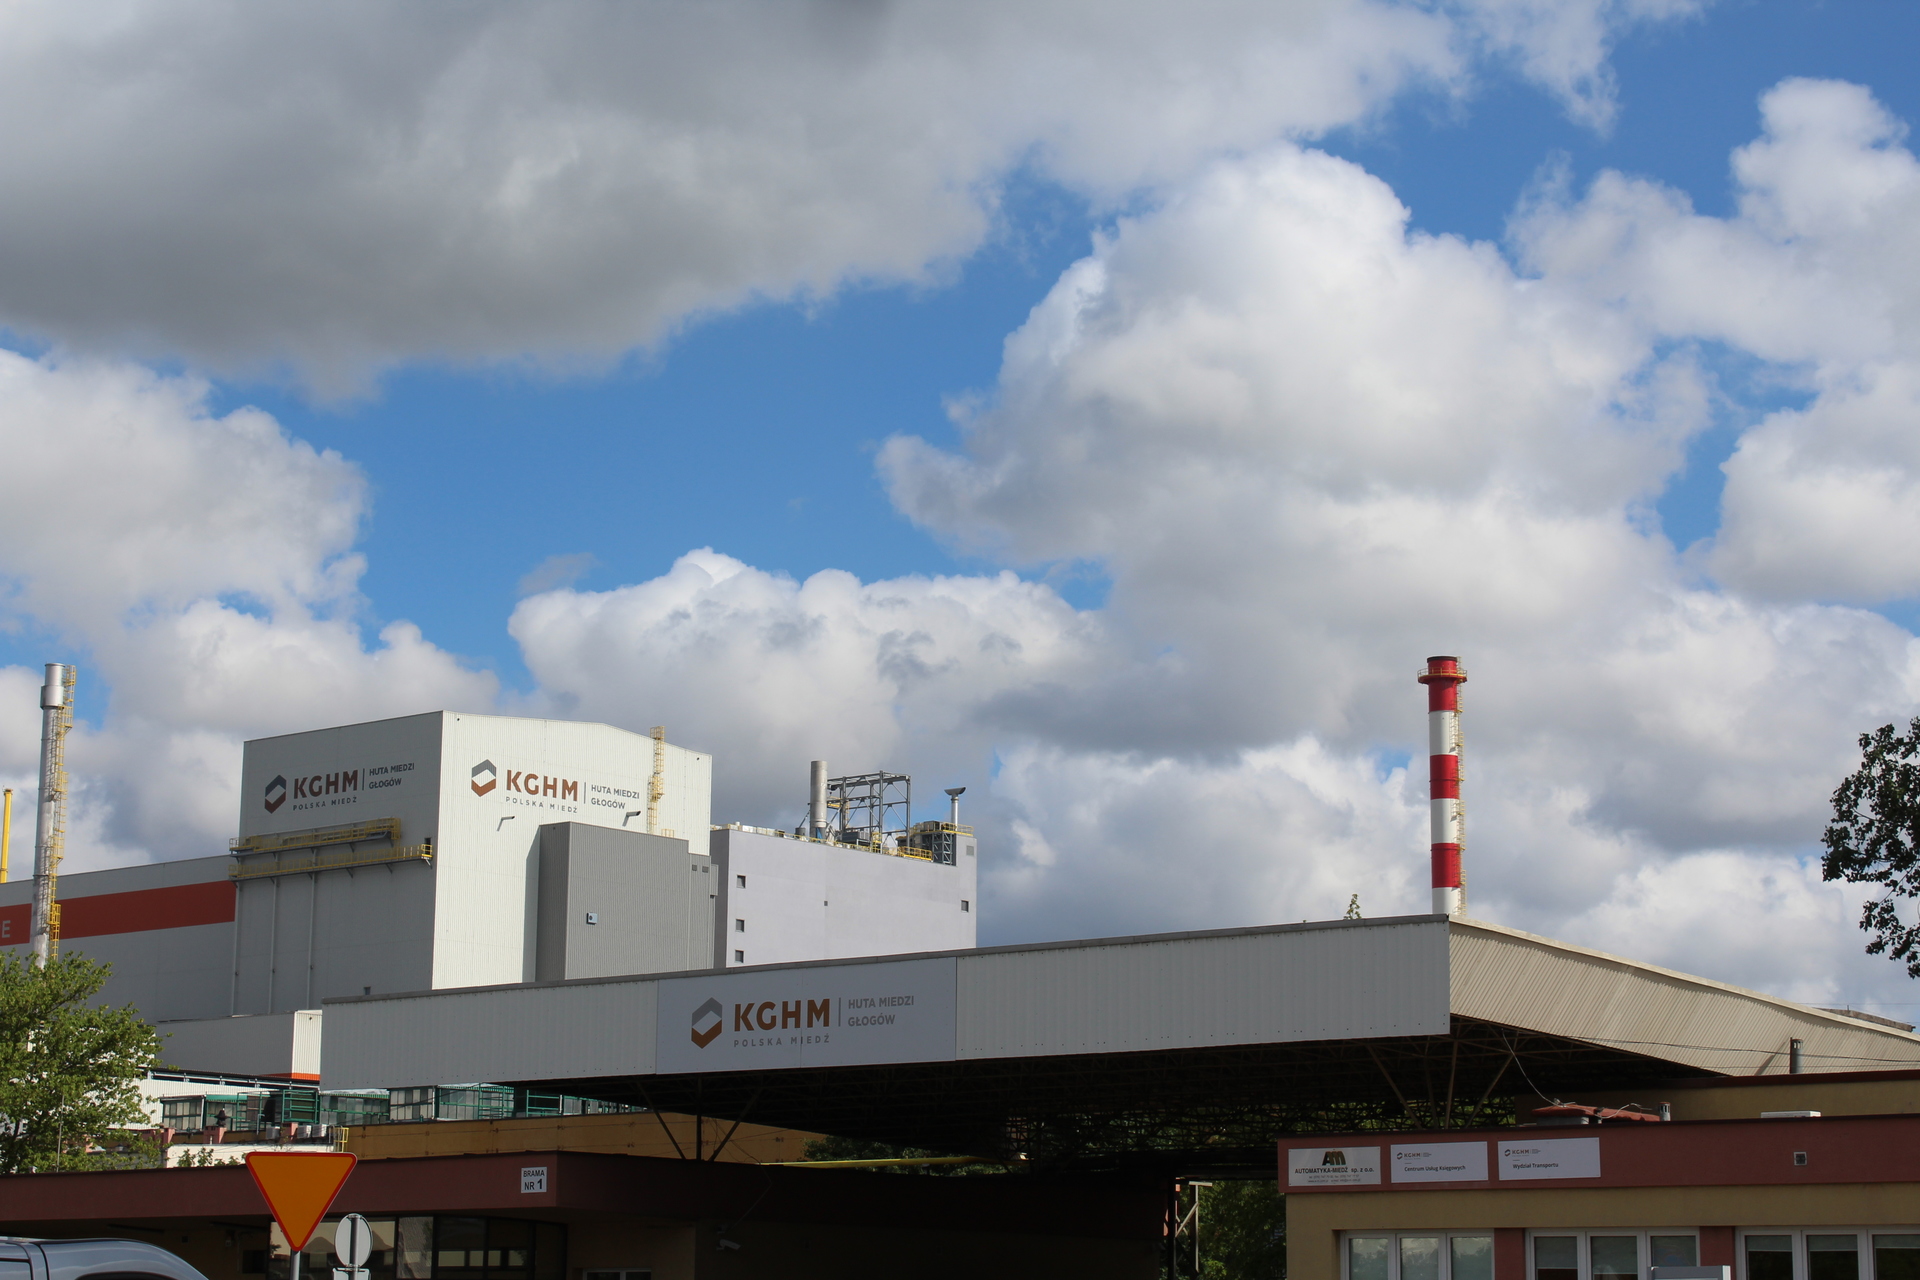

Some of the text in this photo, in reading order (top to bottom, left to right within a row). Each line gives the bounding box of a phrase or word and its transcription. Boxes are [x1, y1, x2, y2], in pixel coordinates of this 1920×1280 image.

[369, 762, 415, 776] HUTA MIEDZI
[294, 770, 358, 800] KGHM
[368, 776, 402, 790] GŁOGÓW
[506, 769, 578, 802] KGHM
[590, 784, 640, 800] HUTA MIEDZI
[292, 800, 327, 811] POLSKA
[505, 796, 544, 808] POLSKA
[590, 796, 626, 810] GŁOGÓW
[848, 996, 914, 1010] HUTA MIEDZI
[734, 998, 830, 1032] KGHM
[848, 1013, 896, 1027] GŁOGÓW
[734, 1034, 830, 1048] POLSKA MIEDŹ
[524, 1178, 542, 1190] NR 1
